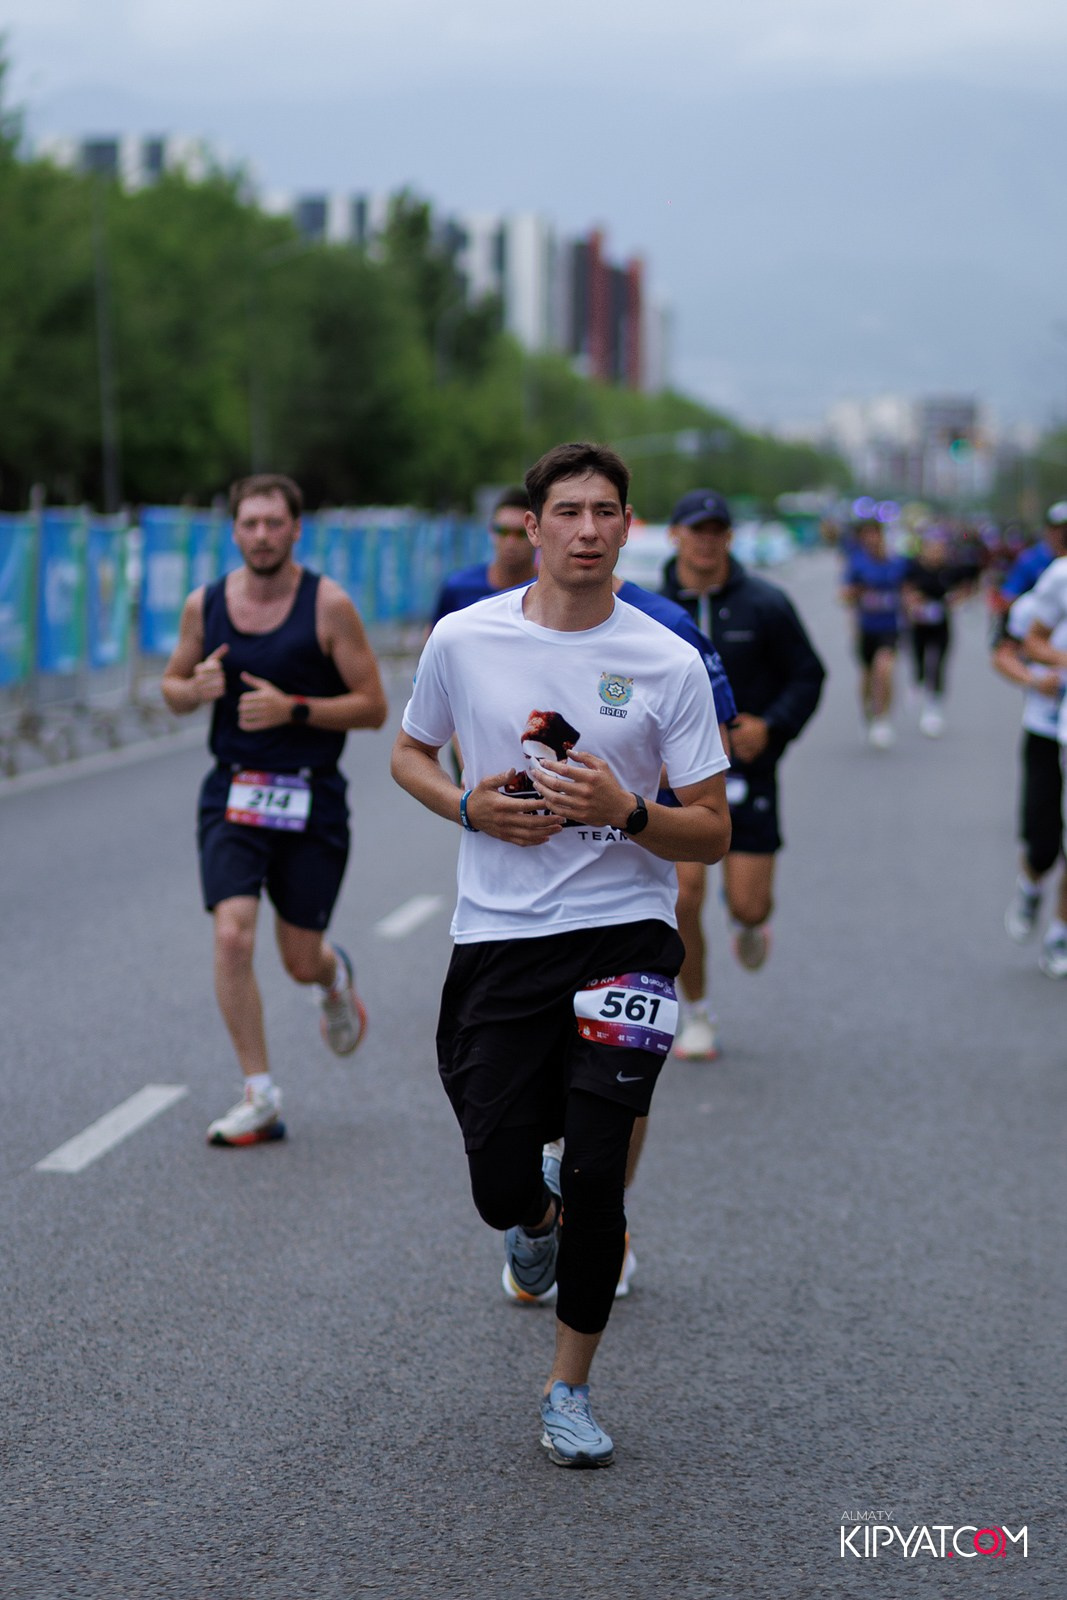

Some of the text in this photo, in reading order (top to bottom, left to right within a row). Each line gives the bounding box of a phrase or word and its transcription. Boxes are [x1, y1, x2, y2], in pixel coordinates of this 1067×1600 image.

[600, 706, 627, 718] ALTAY
[247, 789, 291, 810] 214
[599, 991, 661, 1025] 561
